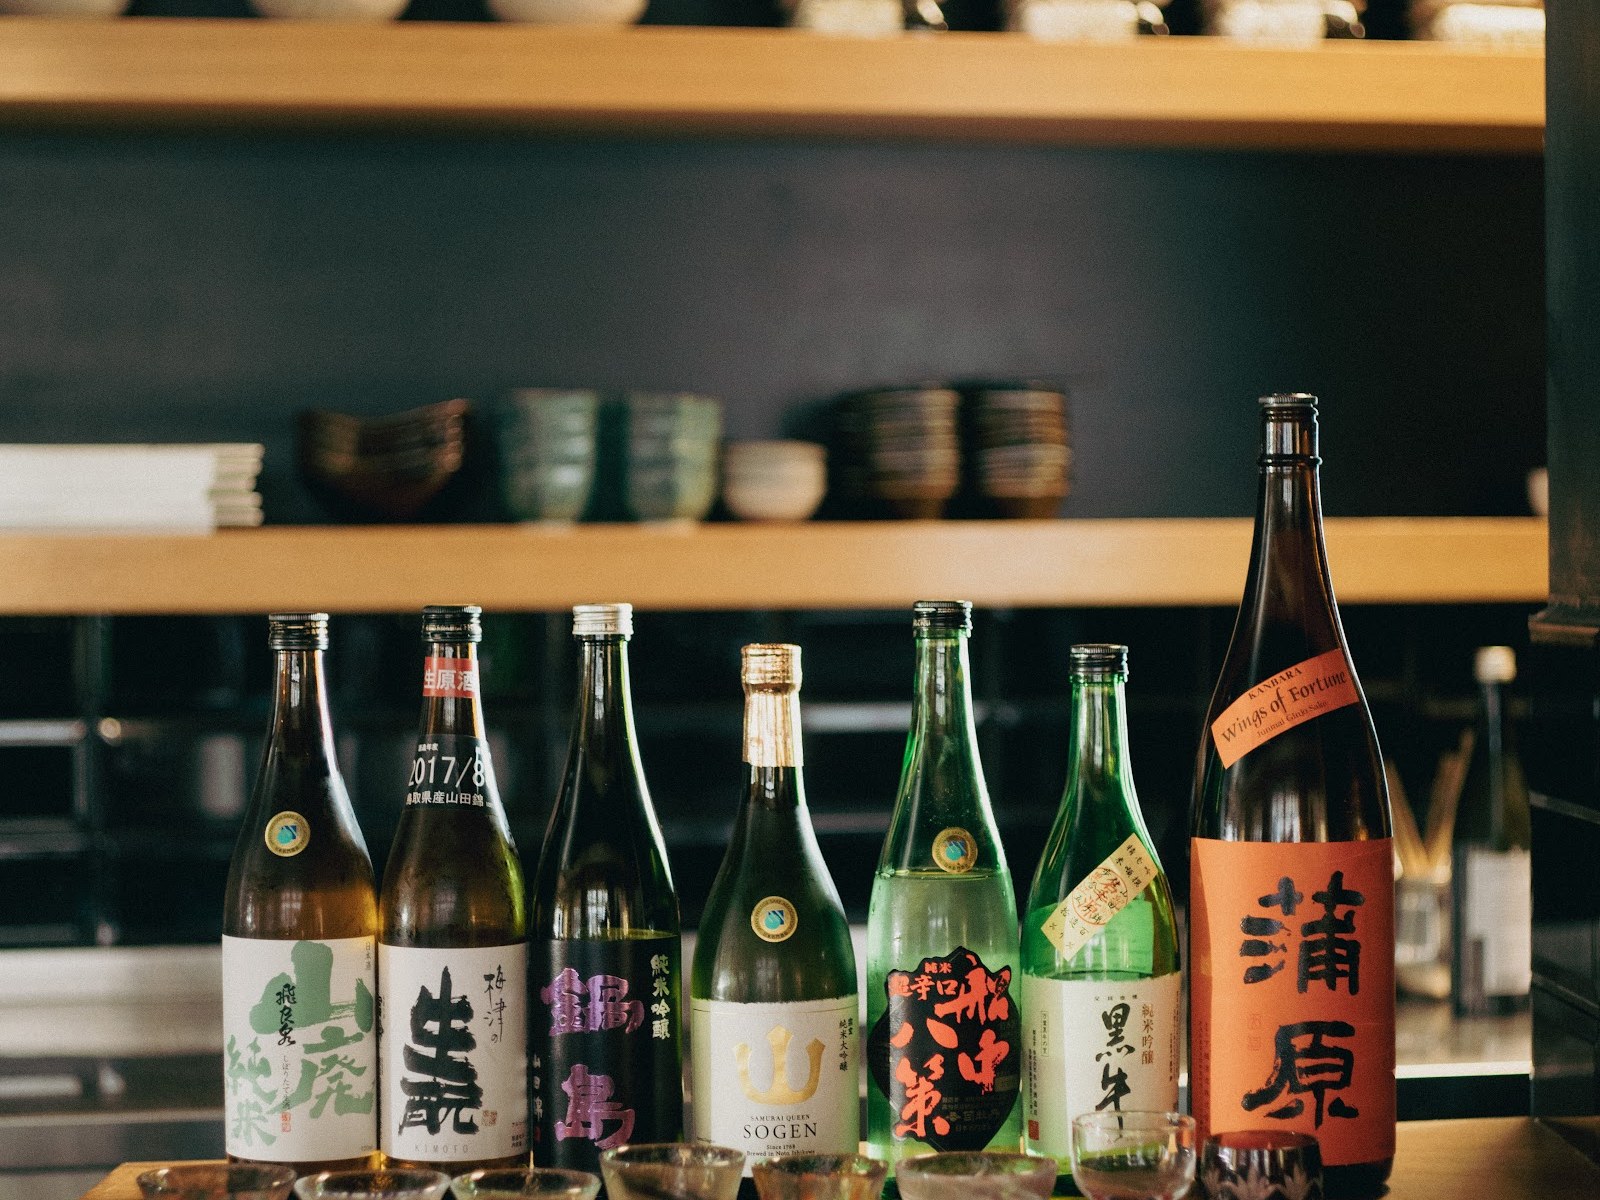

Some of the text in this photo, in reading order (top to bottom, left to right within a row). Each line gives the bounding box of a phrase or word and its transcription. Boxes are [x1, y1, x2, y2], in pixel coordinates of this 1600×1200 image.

[424, 669, 473, 691] 生原酒
[1249, 667, 1302, 700] KANBARA
[1222, 671, 1346, 742] Wings of Fortune
[1257, 718, 1285, 737] Junmai
[1309, 700, 1327, 712] Sake
[408, 756, 485, 787] 2017/8
[924, 962, 952, 974] 純米
[483, 964, 507, 1043] 梅津の
[1239, 870, 1366, 1131] 蒲原
[249, 940, 375, 1119] 山廃
[1095, 1003, 1135, 1141] 黒牛
[415, 1144, 468, 1153] KIMOTO
[744, 1122, 817, 1140] SOGEN
